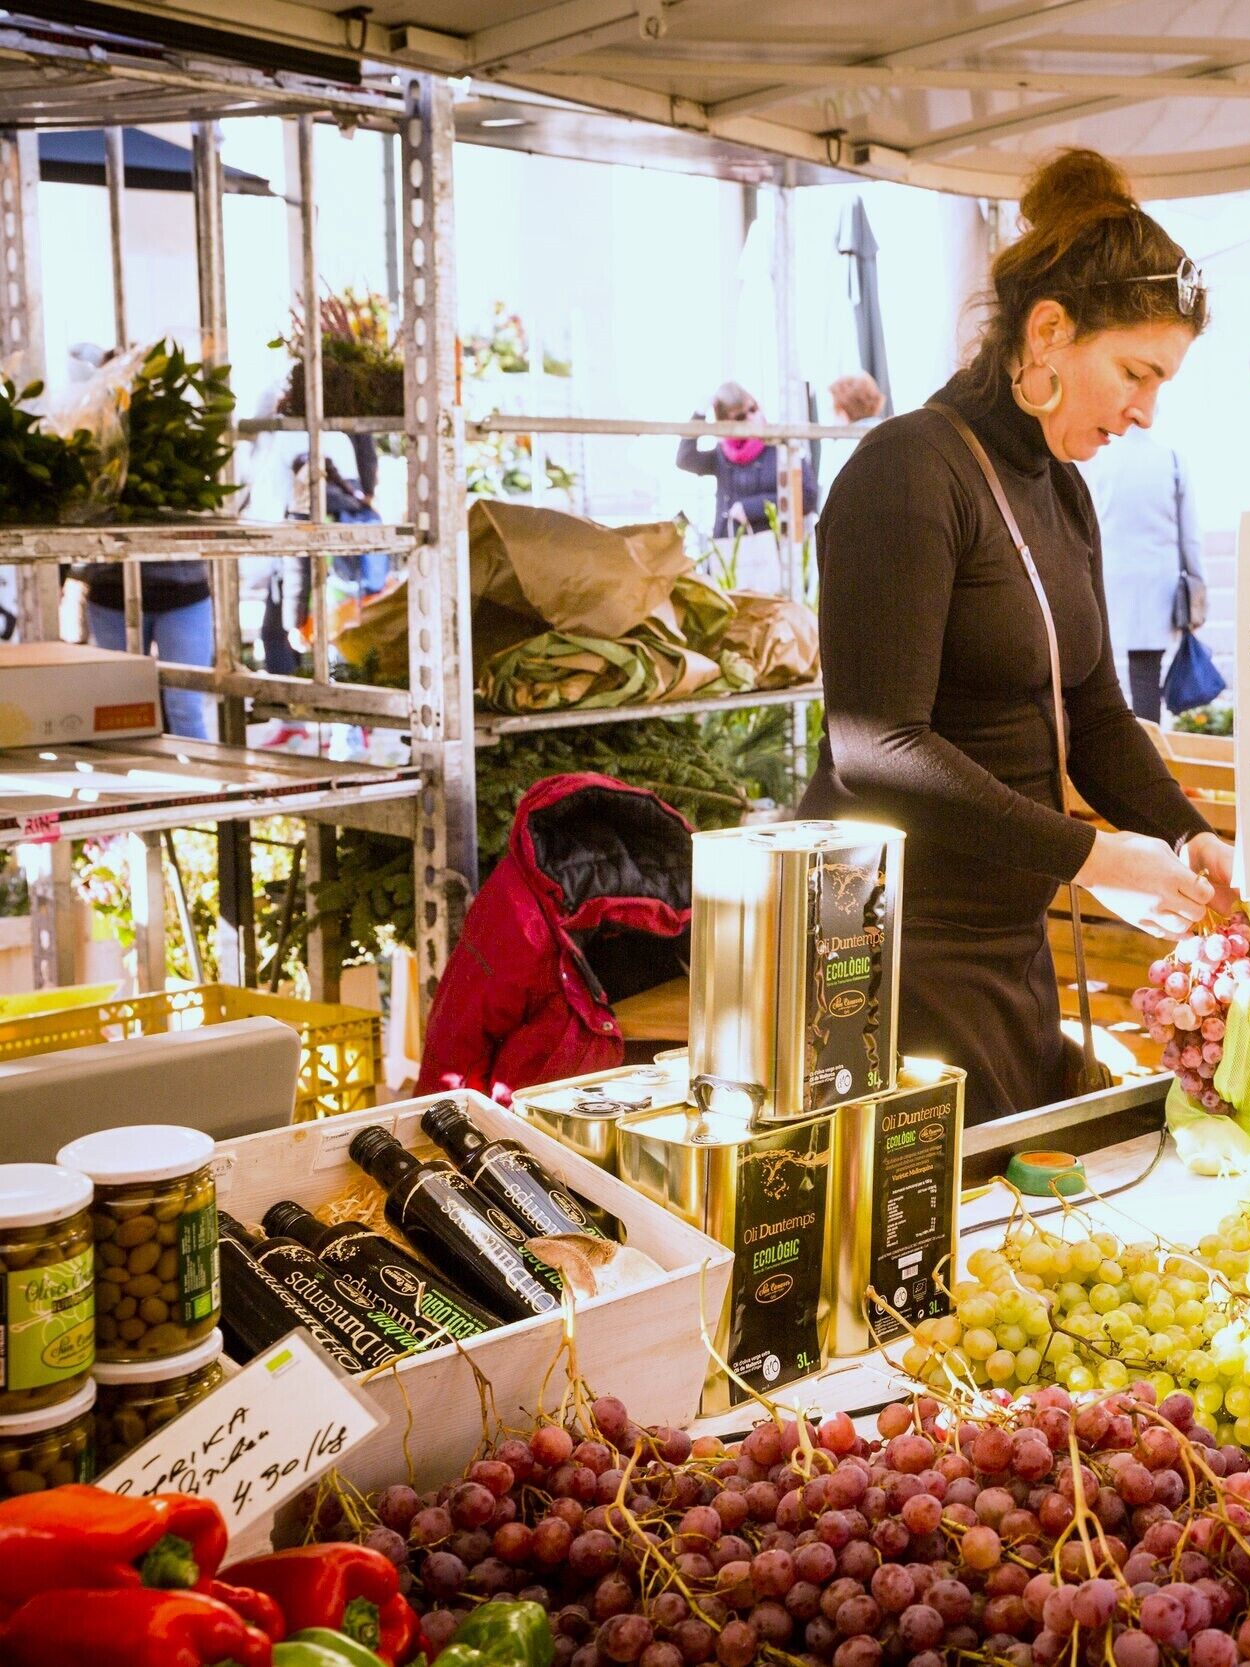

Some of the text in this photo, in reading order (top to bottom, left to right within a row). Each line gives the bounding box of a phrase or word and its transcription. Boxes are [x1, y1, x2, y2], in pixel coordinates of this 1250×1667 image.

[831, 932, 885, 952] Duntemps
[826, 956, 871, 981] ECOLÒGIC
[881, 1103, 951, 1132] Oli Duntemps
[886, 1130, 917, 1150] ECOLÒGIC
[504, 1183, 563, 1236] temps
[743, 1212, 816, 1245] Oli Duntemps
[753, 1238, 800, 1269] ECOLÒGIC
[284, 1271, 382, 1355] Duntemps
